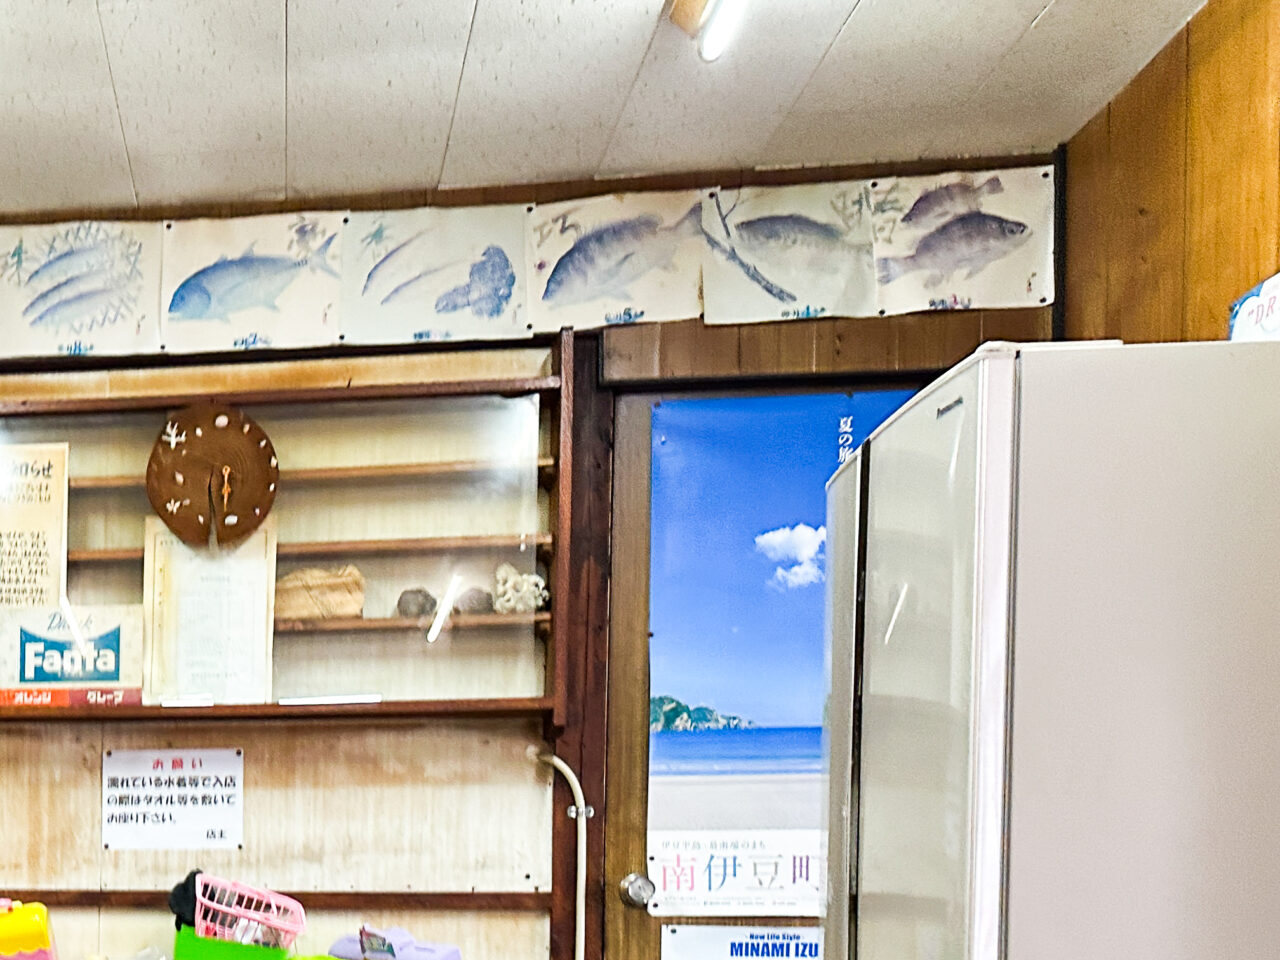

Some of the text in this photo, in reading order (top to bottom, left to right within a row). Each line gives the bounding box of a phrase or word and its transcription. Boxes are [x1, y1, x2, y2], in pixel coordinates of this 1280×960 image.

[24, 641, 116, 680] Fanta
[730, 942, 819, 957] MINAMI IZU
